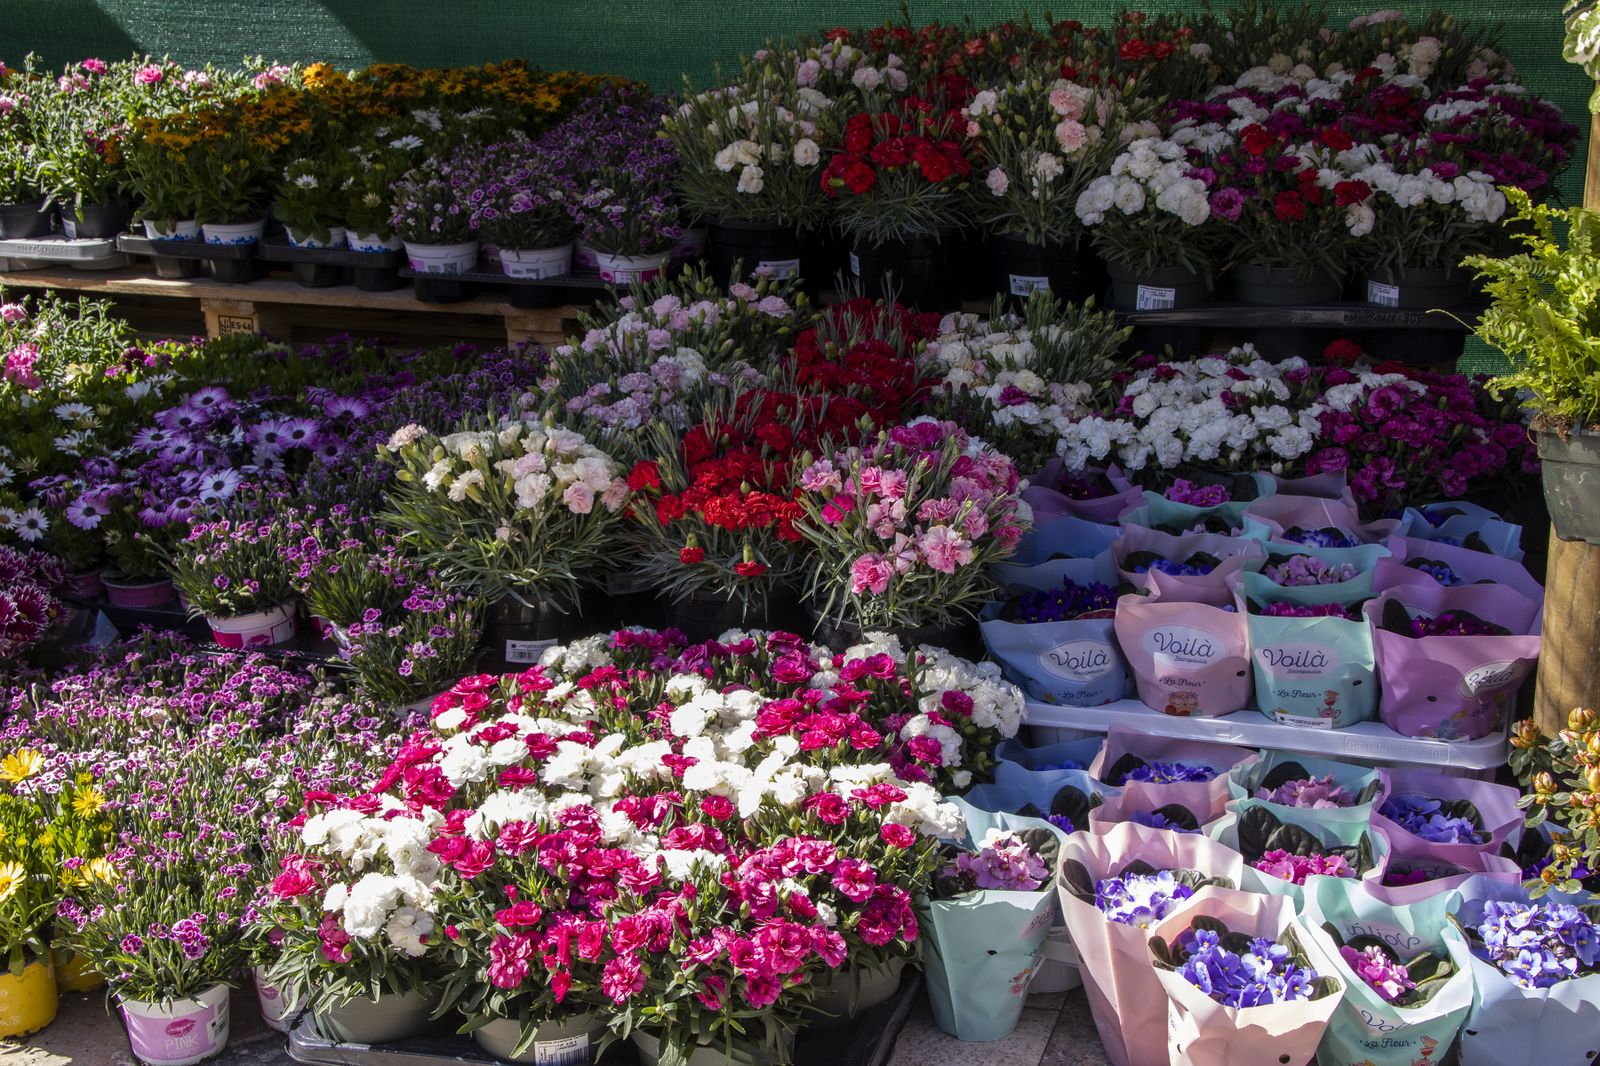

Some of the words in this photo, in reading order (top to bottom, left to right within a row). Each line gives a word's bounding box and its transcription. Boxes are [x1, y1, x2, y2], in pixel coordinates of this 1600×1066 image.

[1153, 631, 1216, 658] Voilà
[1050, 649, 1111, 670] Voilà
[1263, 648, 1329, 668] Voilà
[1164, 677, 1176, 687] La
[1178, 678, 1202, 687] Fleur
[1277, 689, 1289, 699] La
[1291, 689, 1317, 698] Fleur
[1361, 1010, 1410, 1032] Voi
[165, 1033, 201, 1051] PINK
[1381, 1038, 1411, 1049] Fleur
